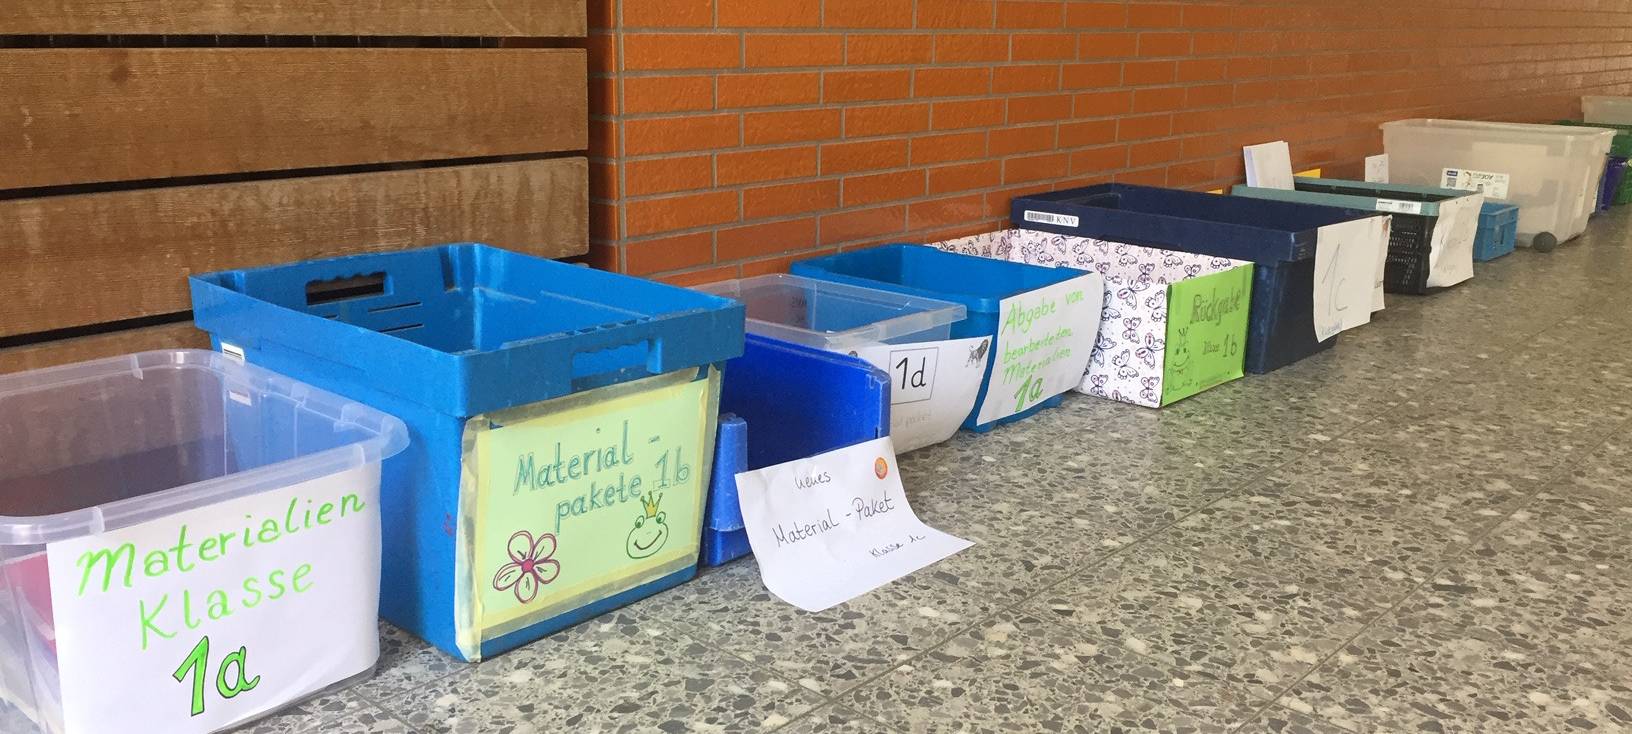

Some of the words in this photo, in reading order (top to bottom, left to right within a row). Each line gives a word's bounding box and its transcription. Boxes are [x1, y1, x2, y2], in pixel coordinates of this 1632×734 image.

[1001, 296, 1057, 336] Abgabe
[1190, 287, 1241, 327] Rückgabe
[1222, 334, 1238, 358] 1b
[896, 356, 926, 390] 1d
[1014, 374, 1044, 412] 1a
[513, 420, 633, 496] Material
[556, 472, 642, 535] pakete
[653, 445, 691, 492] 1b
[75, 493, 366, 597] Materialien
[772, 508, 840, 547] Material
[138, 562, 315, 651] Klasse
[172, 635, 261, 717] 1a
